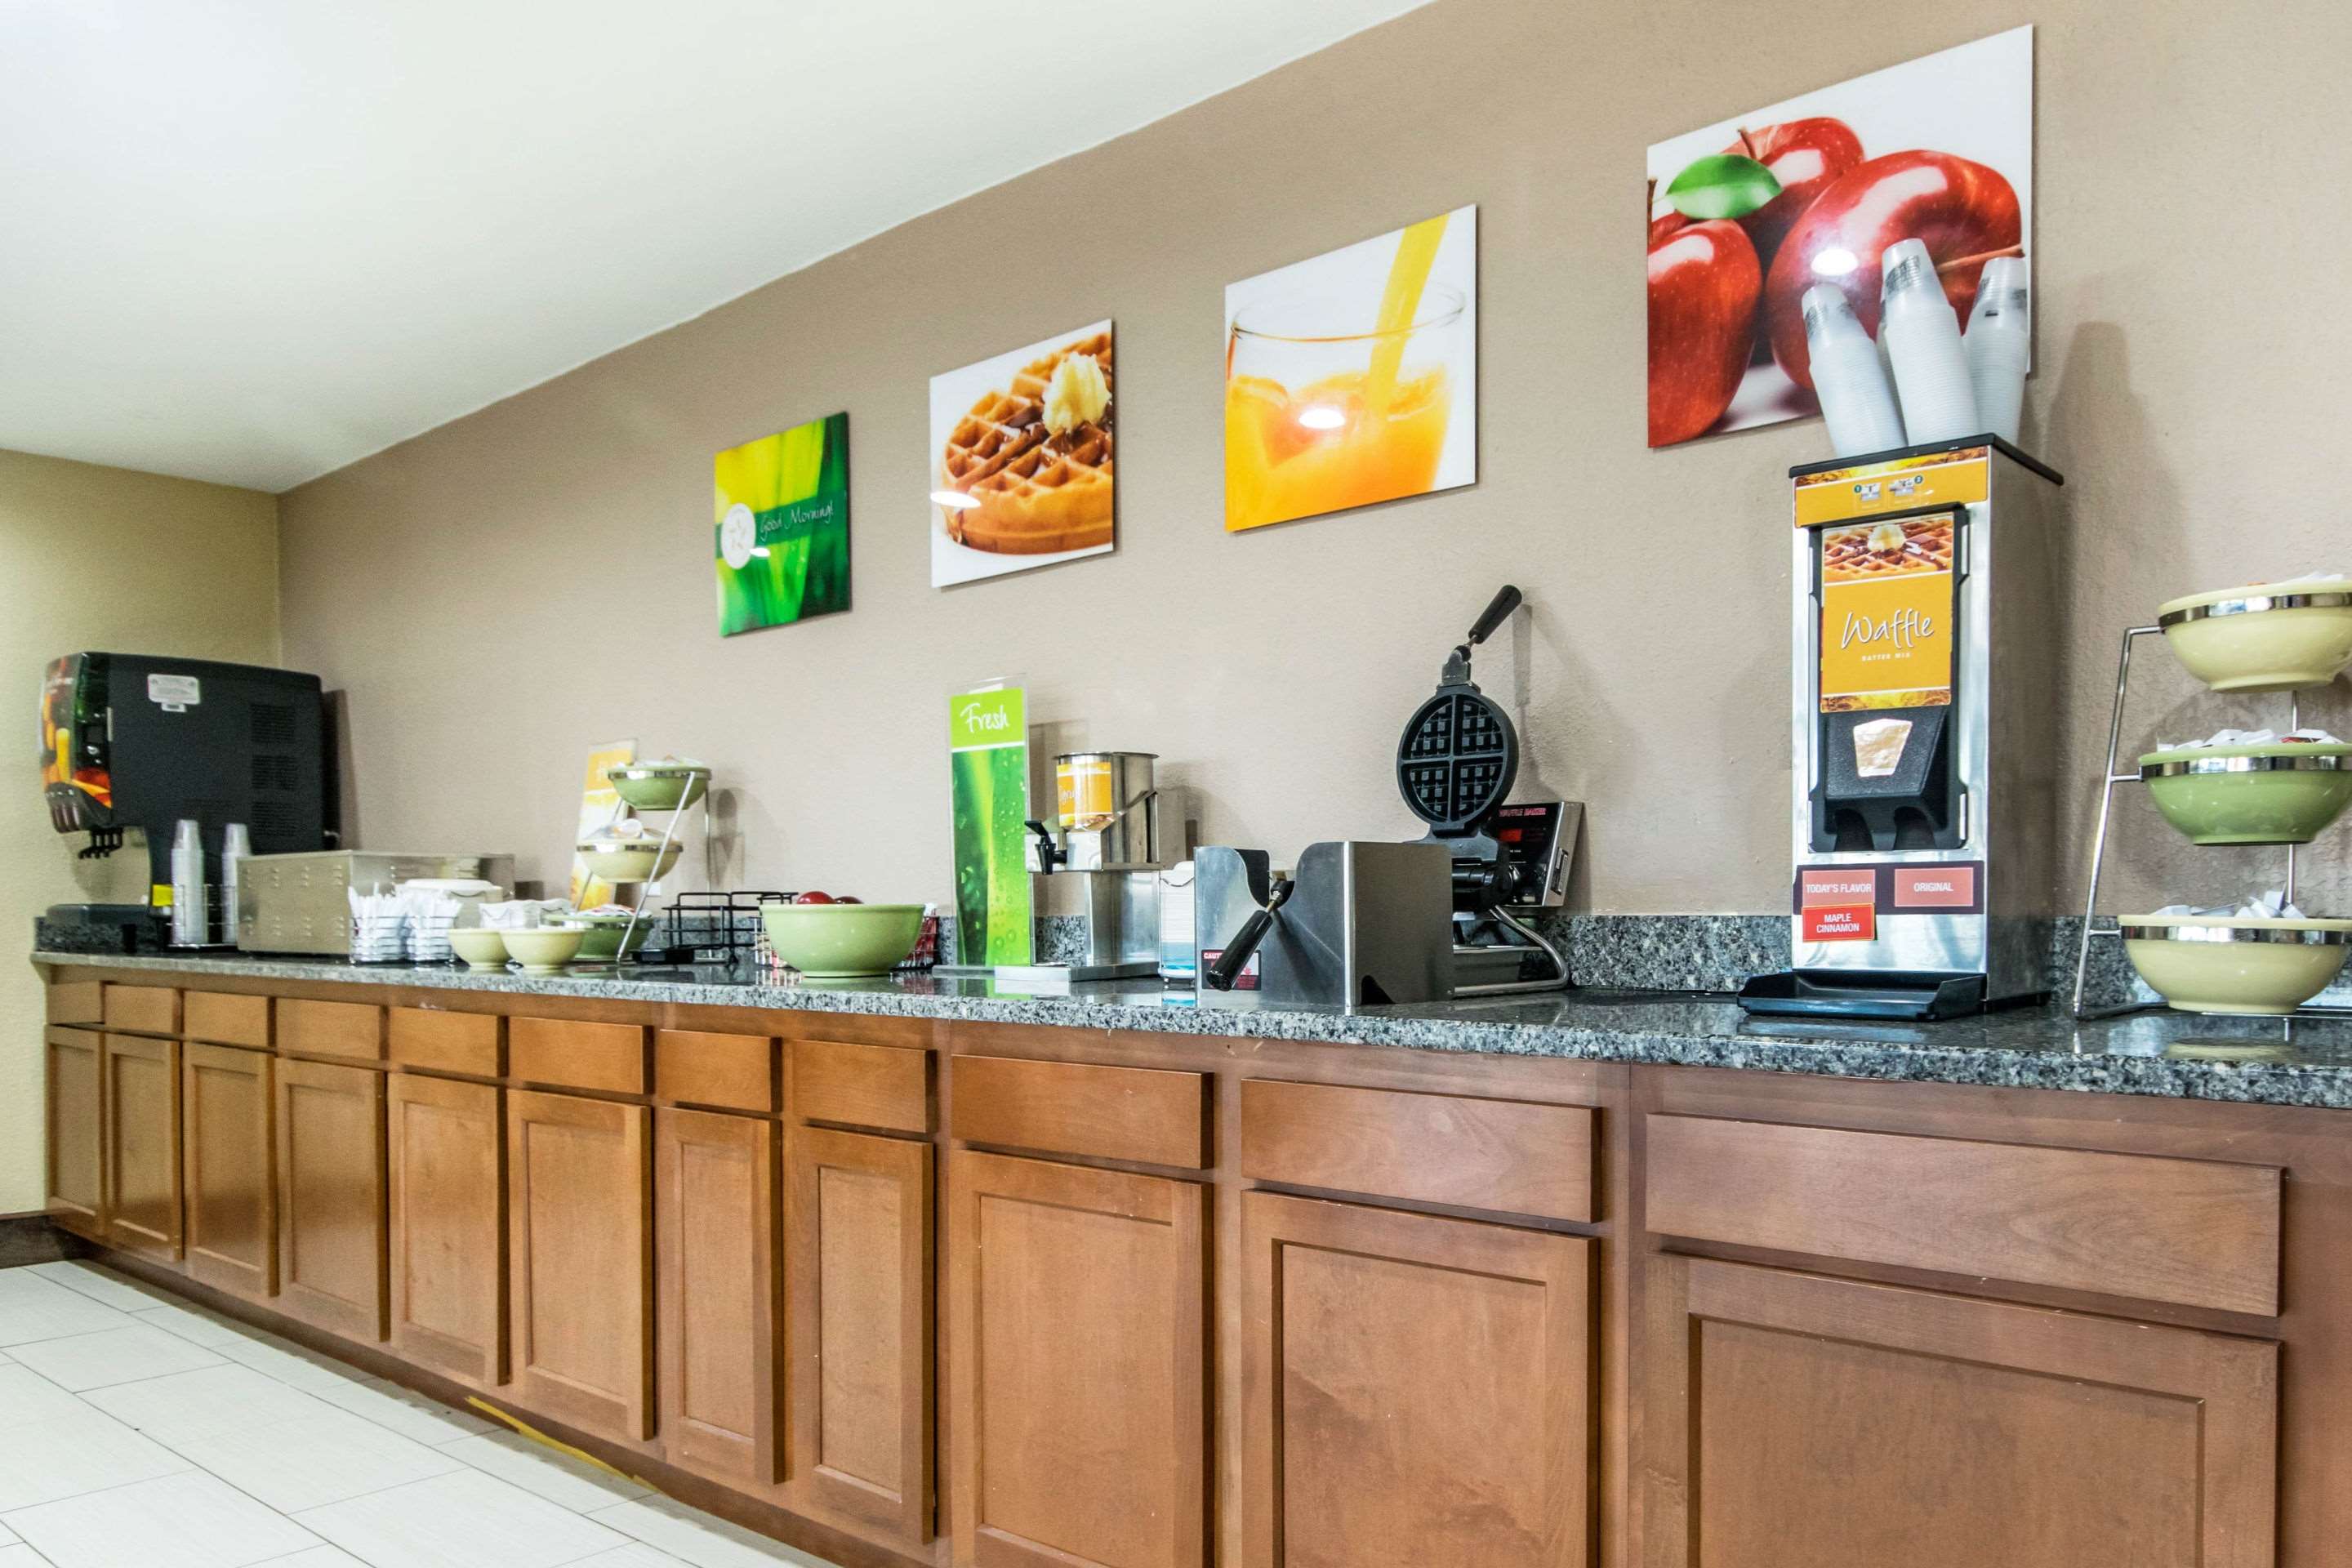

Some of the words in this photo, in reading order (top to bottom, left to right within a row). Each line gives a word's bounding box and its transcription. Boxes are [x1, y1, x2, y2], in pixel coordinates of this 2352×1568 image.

[760, 512, 783, 542] Good
[1841, 608, 1935, 650] Waffle
[1861, 653, 1892, 662] BATTER
[960, 702, 1010, 733] Fresh
[1806, 884, 1839, 893] TODAY'S
[1840, 884, 1872, 893] FLAVOR
[1913, 882, 1953, 892] ORIGINAL
[1824, 913, 1852, 923] MAPLE
[1816, 923, 1860, 933] CINNAMON
